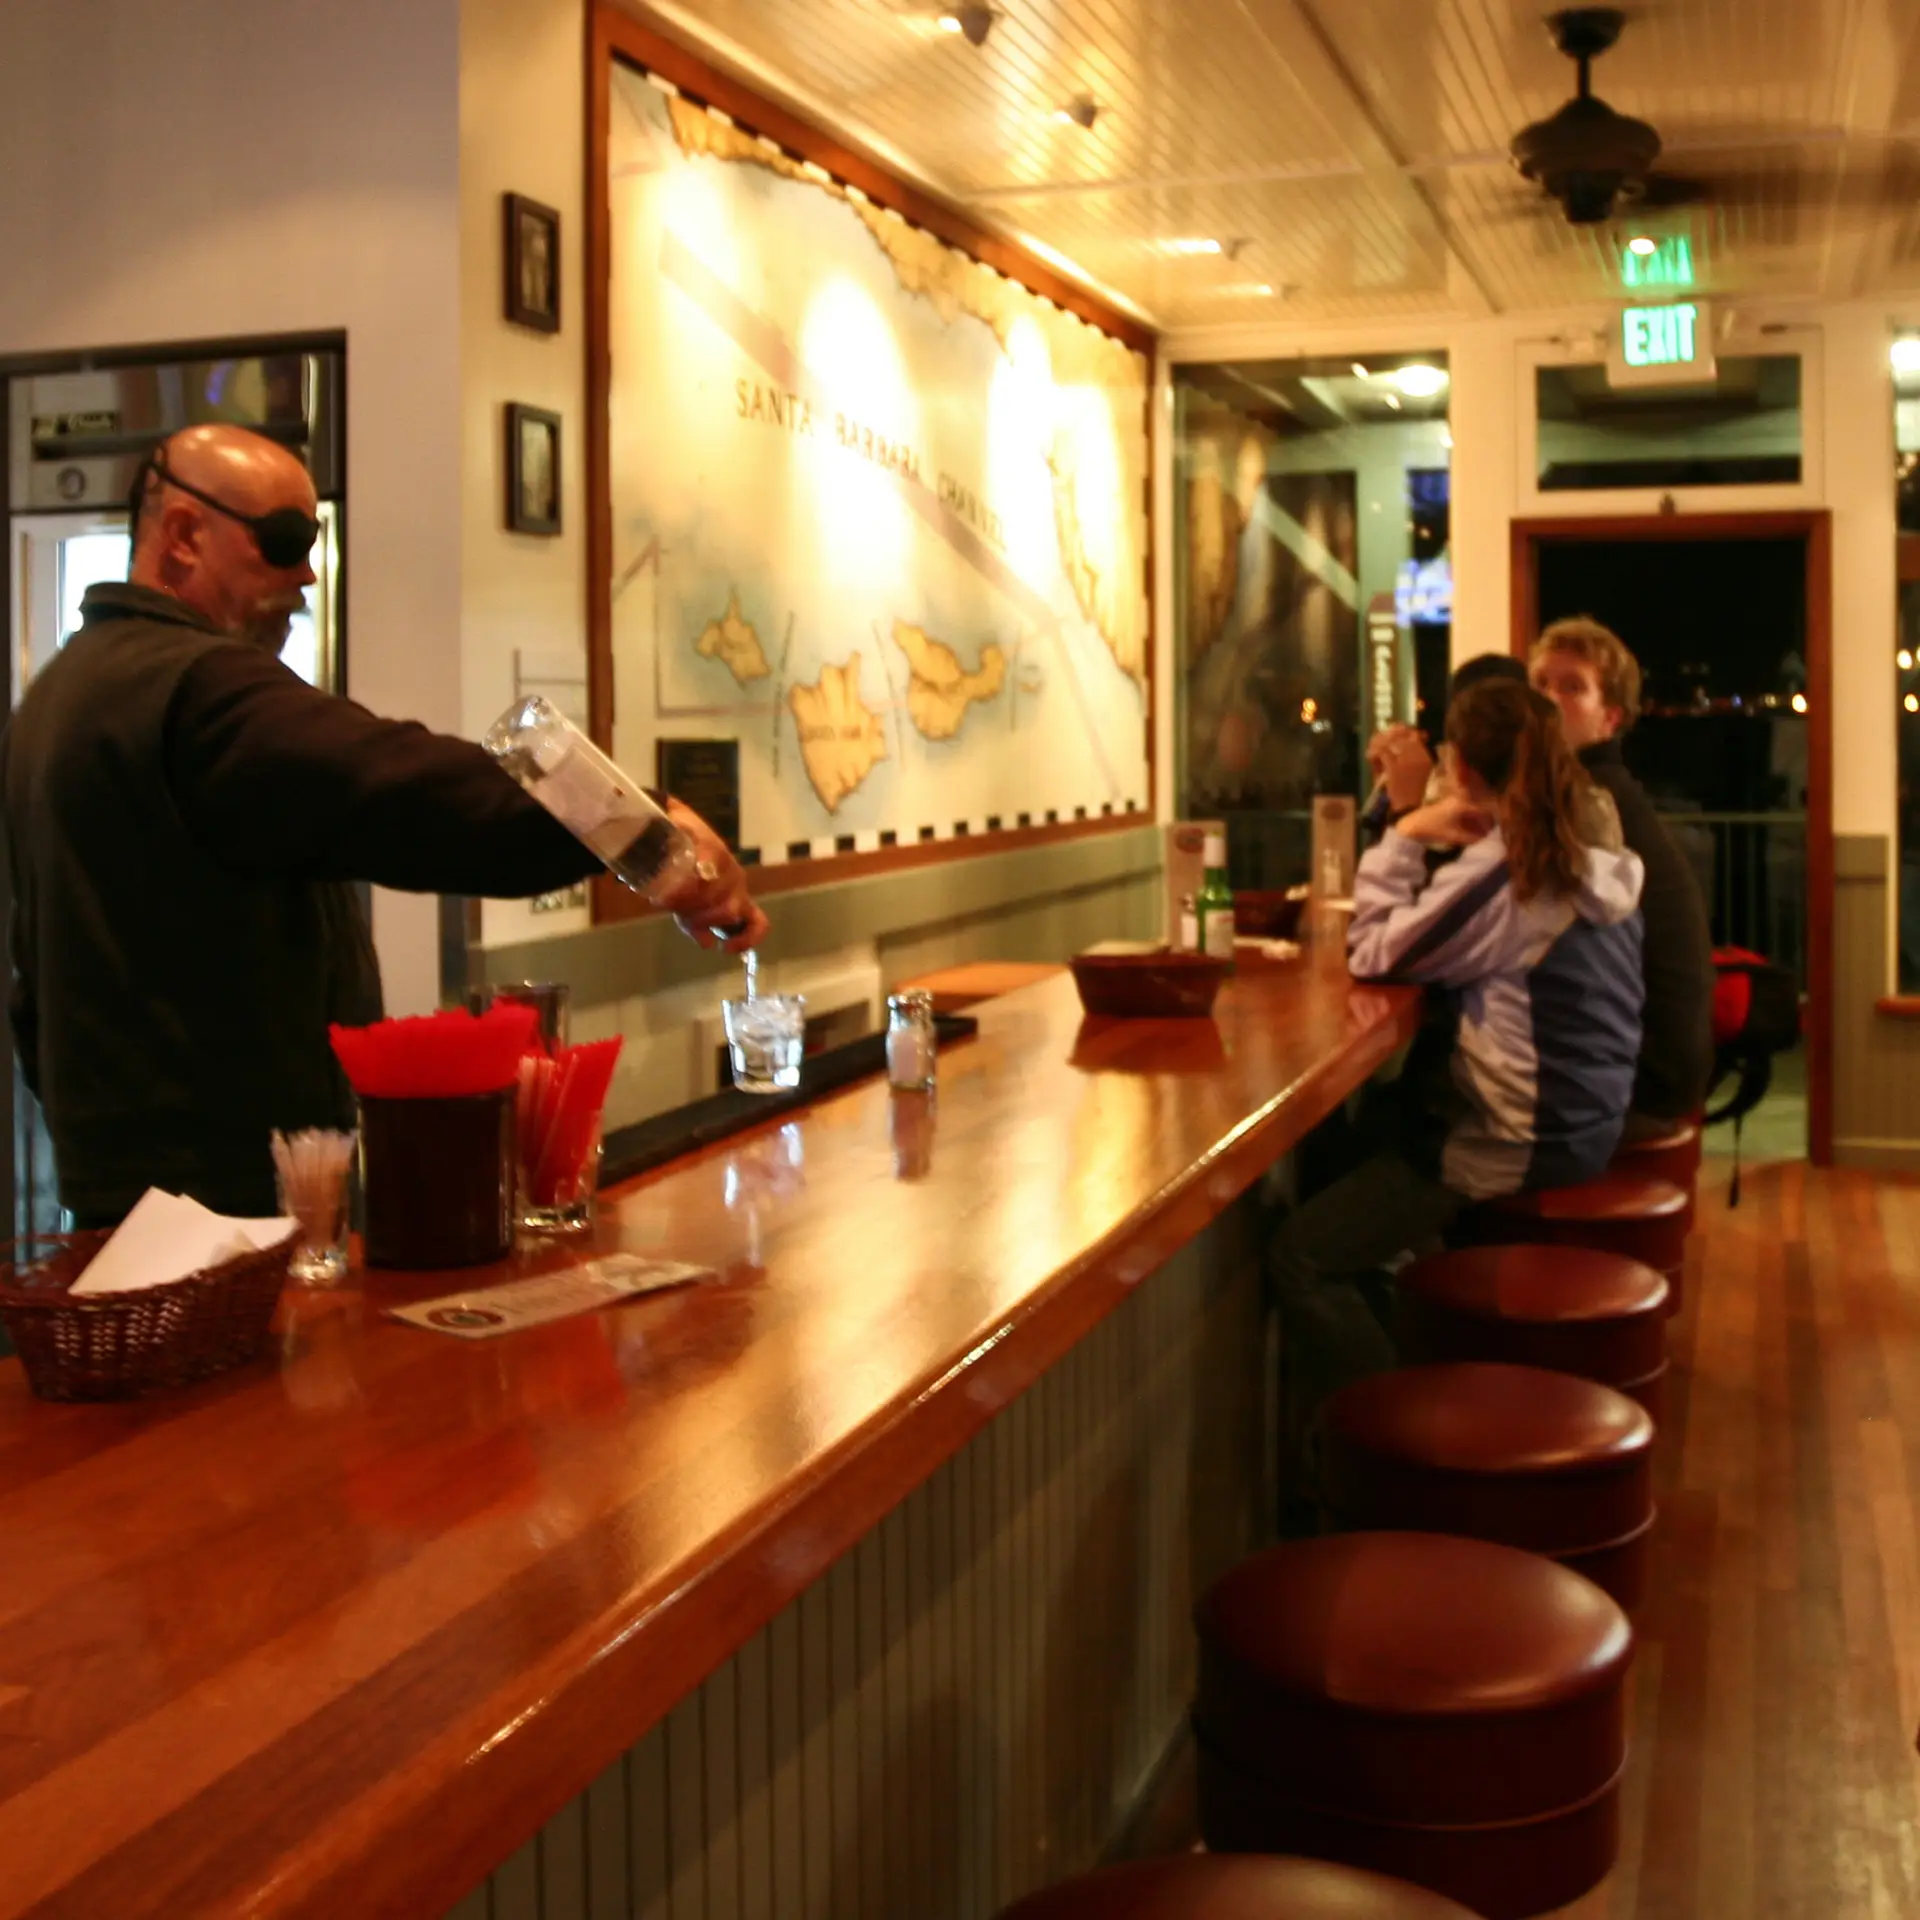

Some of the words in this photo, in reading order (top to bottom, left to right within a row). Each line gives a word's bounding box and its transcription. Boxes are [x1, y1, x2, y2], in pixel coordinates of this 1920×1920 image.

[1622, 303, 1697, 366] EXIT
[735, 377, 813, 437] SANTA
[835, 411, 920, 481] BARBARA
